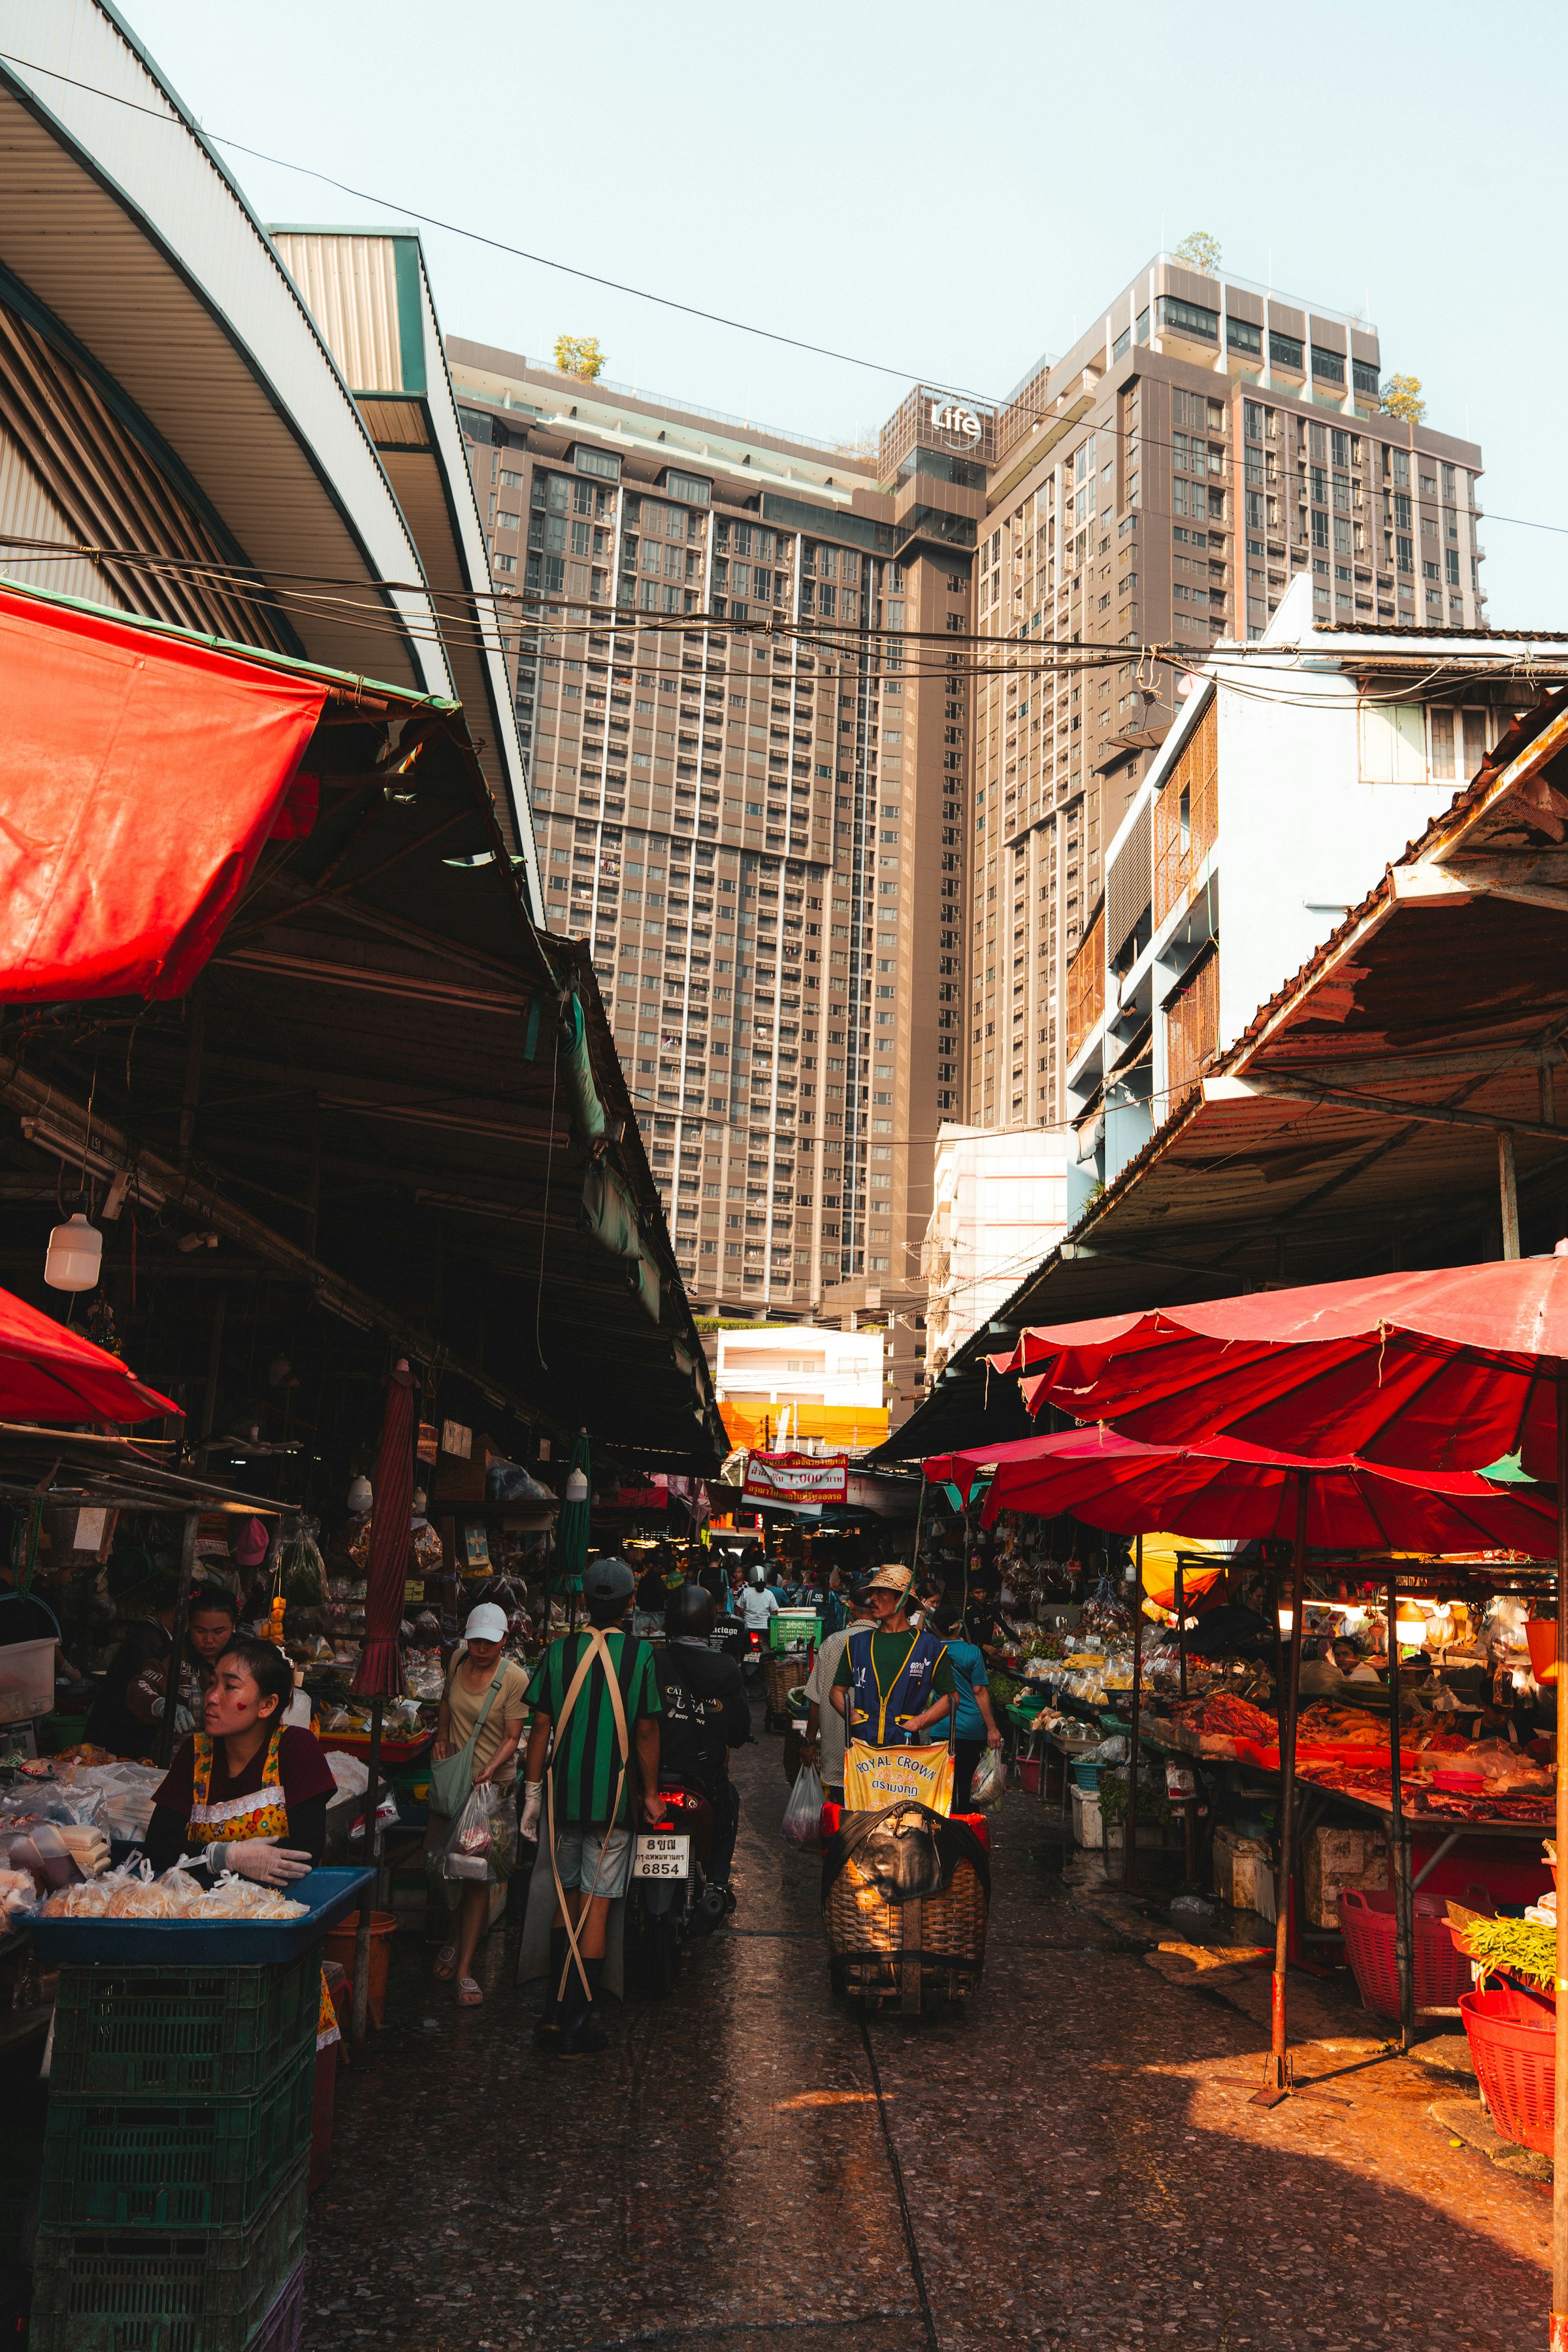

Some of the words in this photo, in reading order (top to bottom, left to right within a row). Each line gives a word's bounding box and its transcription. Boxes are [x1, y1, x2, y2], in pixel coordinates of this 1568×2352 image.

[931, 404, 981, 436] Life
[789, 1473, 823, 1484] 1,000
[857, 1756, 891, 1774] ROYAL
[898, 1756, 937, 1780] CROWN
[872, 1780, 919, 1797] ตรามงกุฎ
[642, 1863, 679, 1874] 6854
